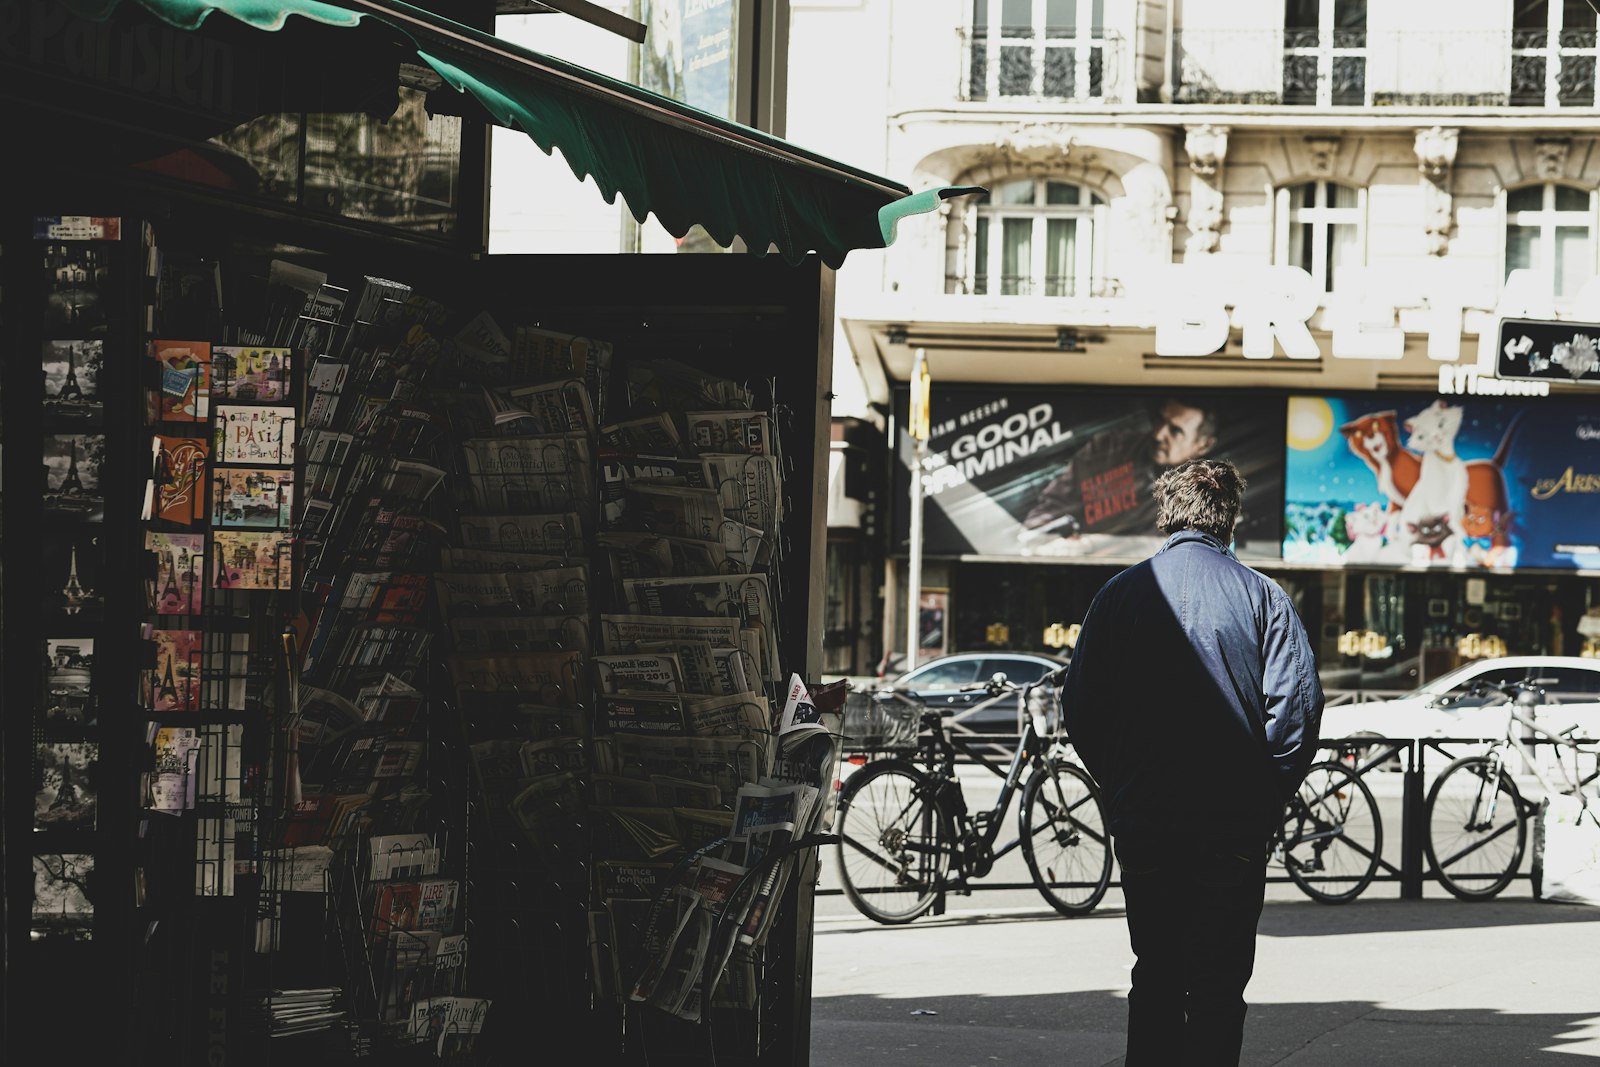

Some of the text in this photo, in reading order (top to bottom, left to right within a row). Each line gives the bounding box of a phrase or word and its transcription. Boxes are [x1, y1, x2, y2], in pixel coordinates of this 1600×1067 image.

[30, 2, 233, 115] Parisien
[931, 397, 1009, 438] IAM NEESON
[950, 402, 1053, 460] GOOD
[1084, 489, 1137, 526] CHANCE
[609, 659, 660, 670] CHARLIE HEBDO
[646, 672, 671, 681] 2015
[618, 867, 652, 876] france
[210, 949, 229, 995] LE
